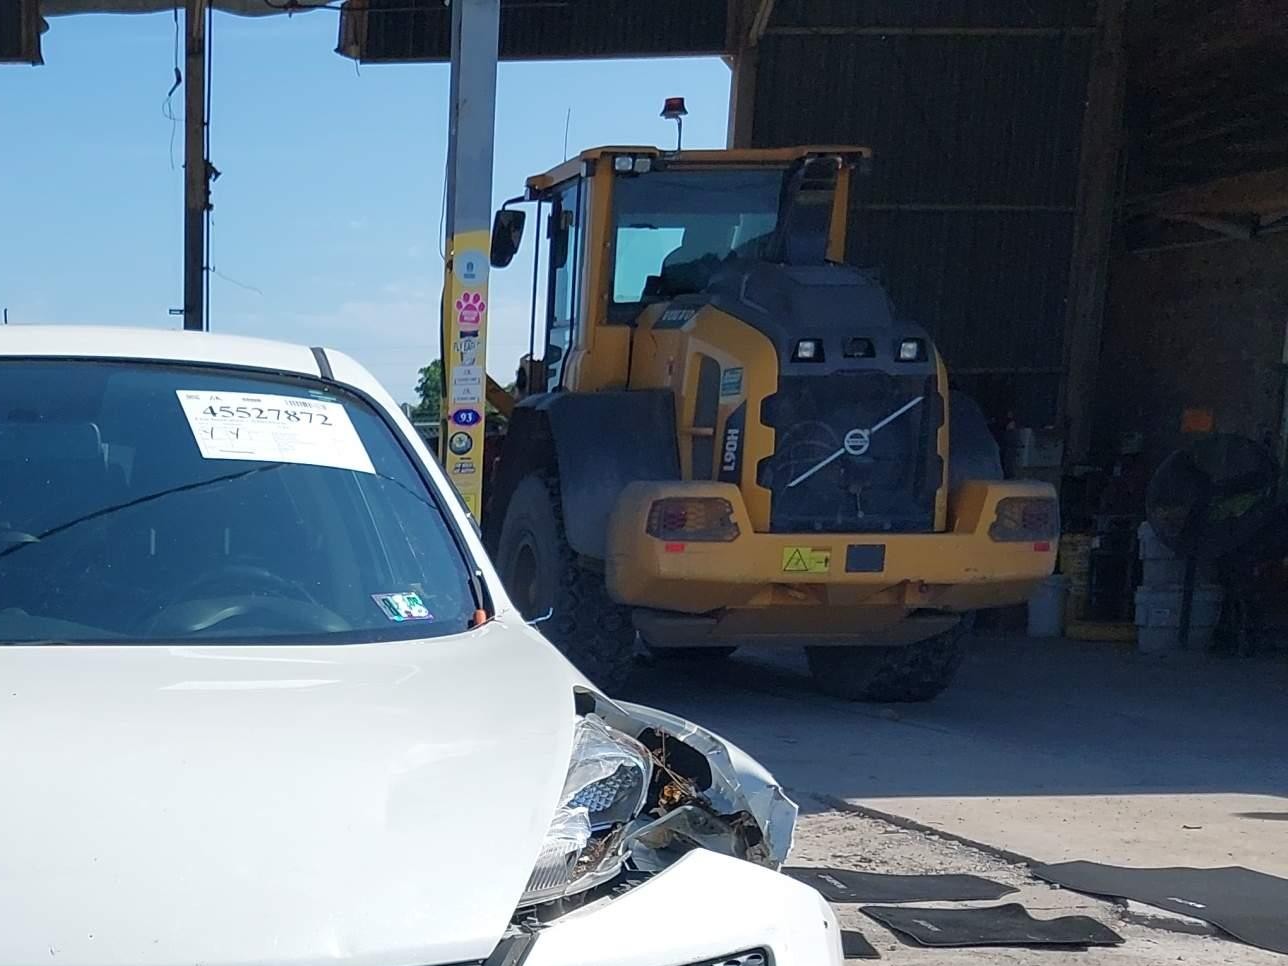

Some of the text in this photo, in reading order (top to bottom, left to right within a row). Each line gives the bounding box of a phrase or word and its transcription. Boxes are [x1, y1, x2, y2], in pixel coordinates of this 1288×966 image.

[202, 405, 333, 426] 45527872
[459, 412, 473, 423] 93
[722, 428, 741, 472] L90H
